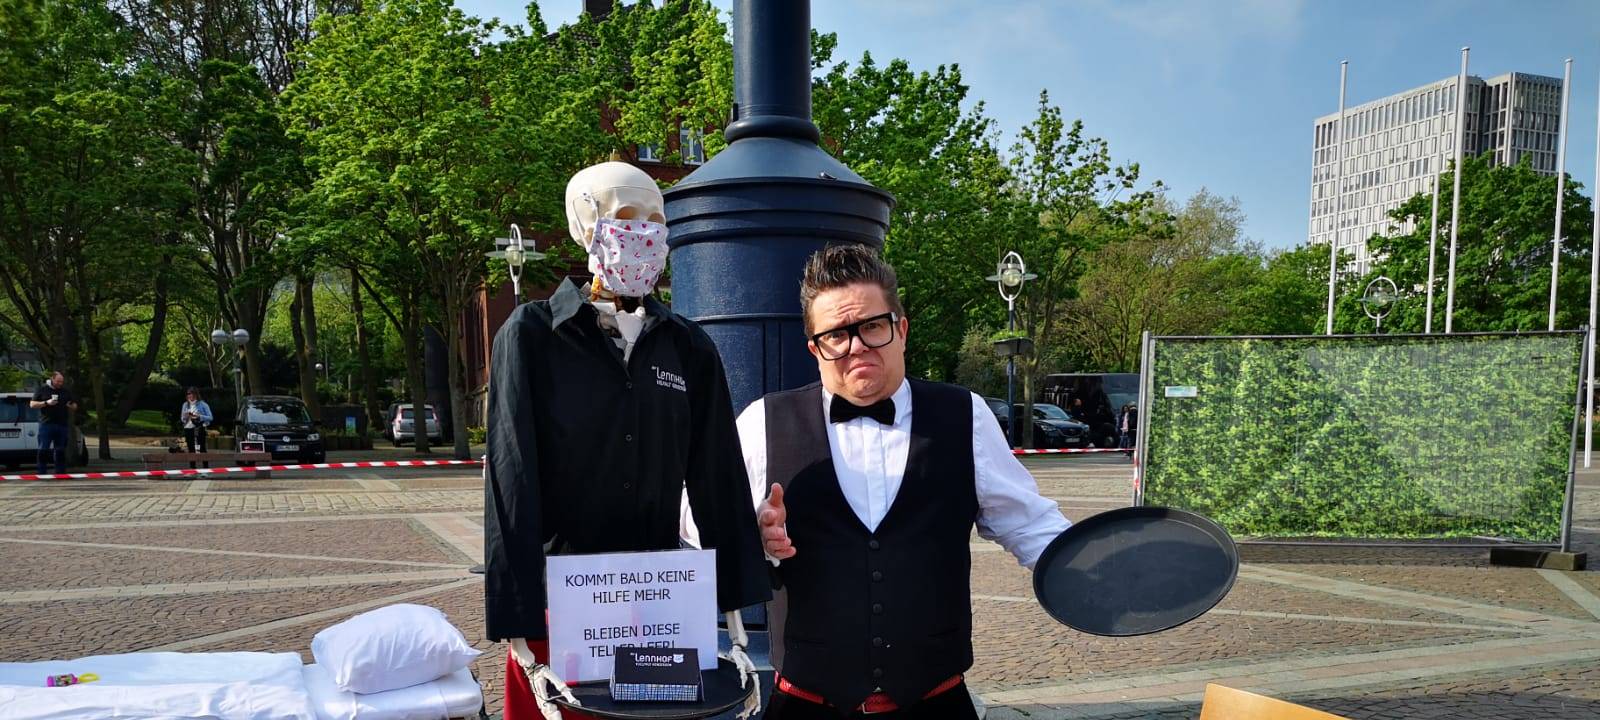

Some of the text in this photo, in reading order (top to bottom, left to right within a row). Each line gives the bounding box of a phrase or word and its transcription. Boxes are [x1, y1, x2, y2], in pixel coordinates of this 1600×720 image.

[565, 569, 696, 588] KOMMT BALD KEINE
[593, 588, 671, 604] HILFE MEHR
[584, 623, 681, 641] BLEIBEN DIESE
